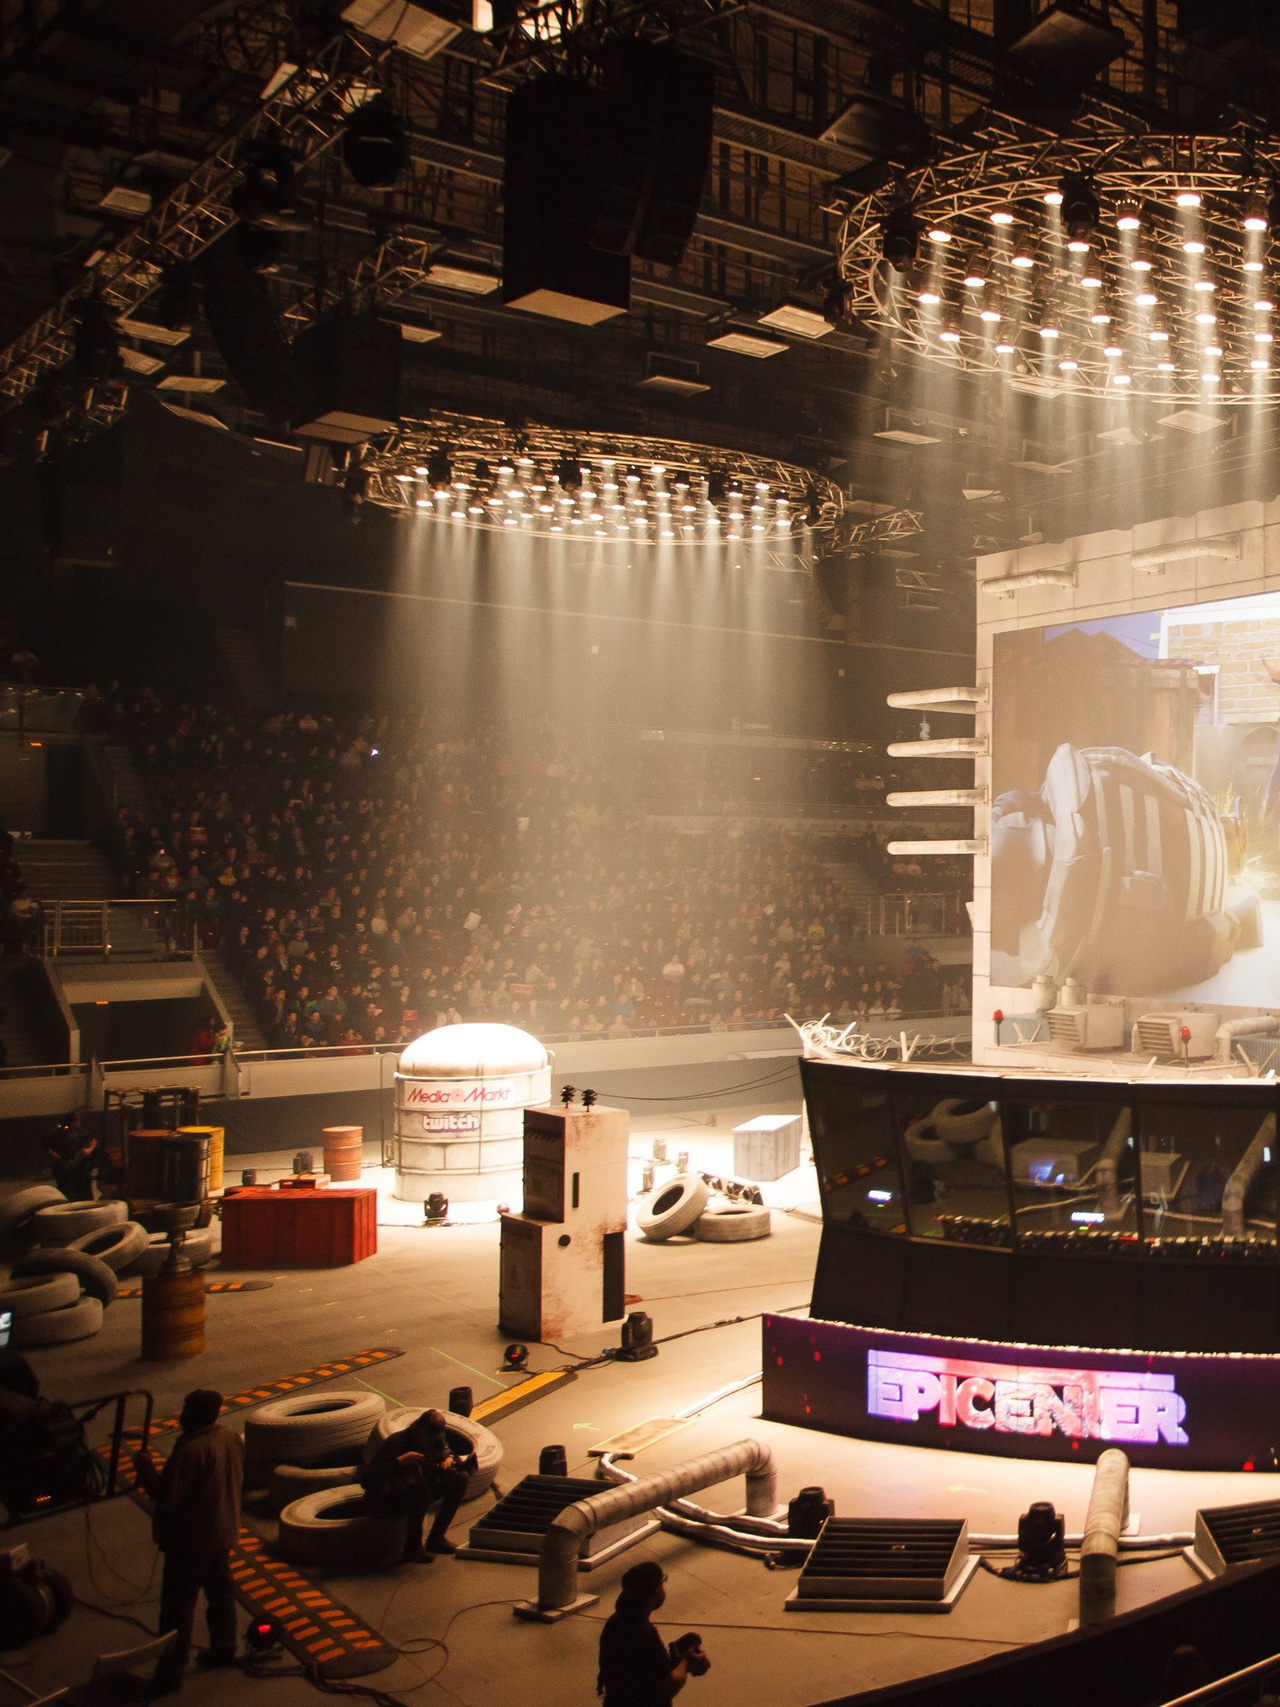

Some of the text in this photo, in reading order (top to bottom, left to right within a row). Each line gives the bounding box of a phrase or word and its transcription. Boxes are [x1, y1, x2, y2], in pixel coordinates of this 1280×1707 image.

[407, 1087, 510, 1103] Media Markt
[422, 1114, 480, 1133] twitch
[867, 1349, 1190, 1444] EPICENTER
